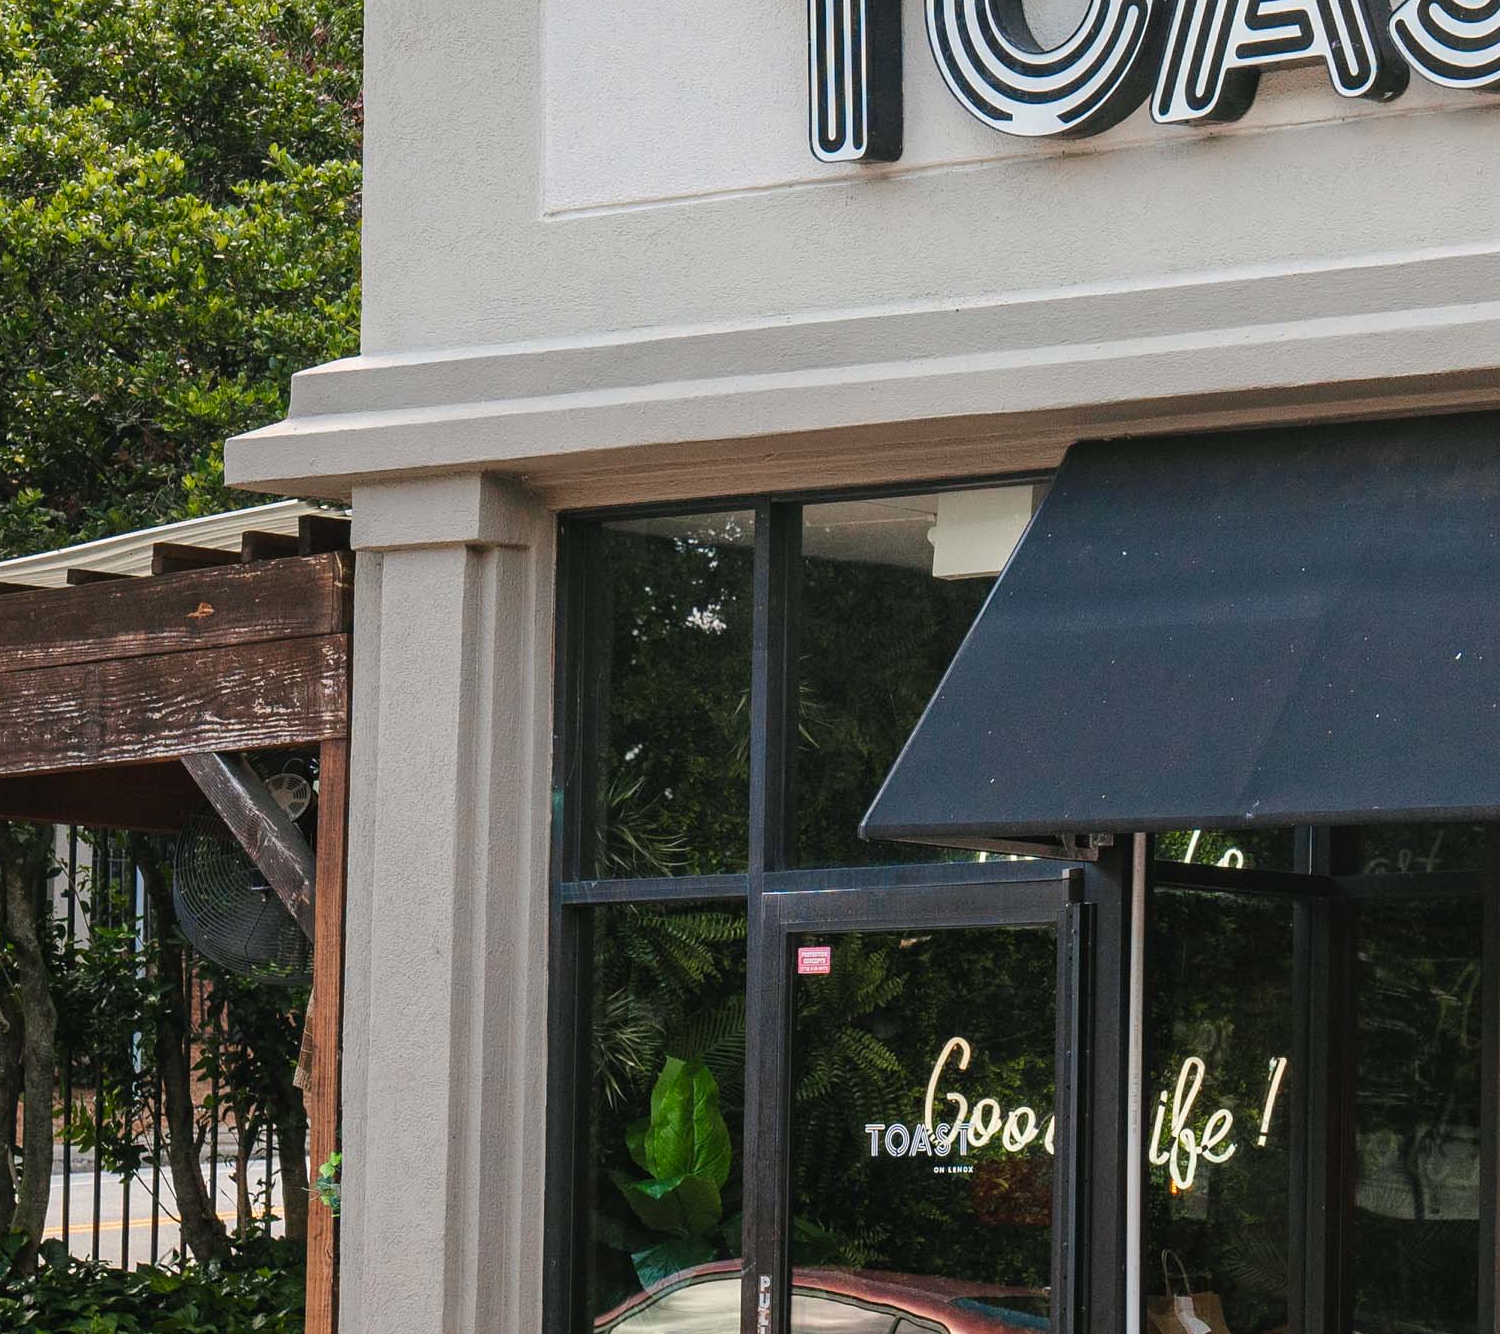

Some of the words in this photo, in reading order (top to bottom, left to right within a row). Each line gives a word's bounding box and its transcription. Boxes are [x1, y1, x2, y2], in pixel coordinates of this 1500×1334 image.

[924, 1037, 1056, 1155] Goo
[865, 1123, 974, 1157] TOAST
[933, 1165, 946, 1174] ON
[947, 1165, 974, 1174] LENOX
